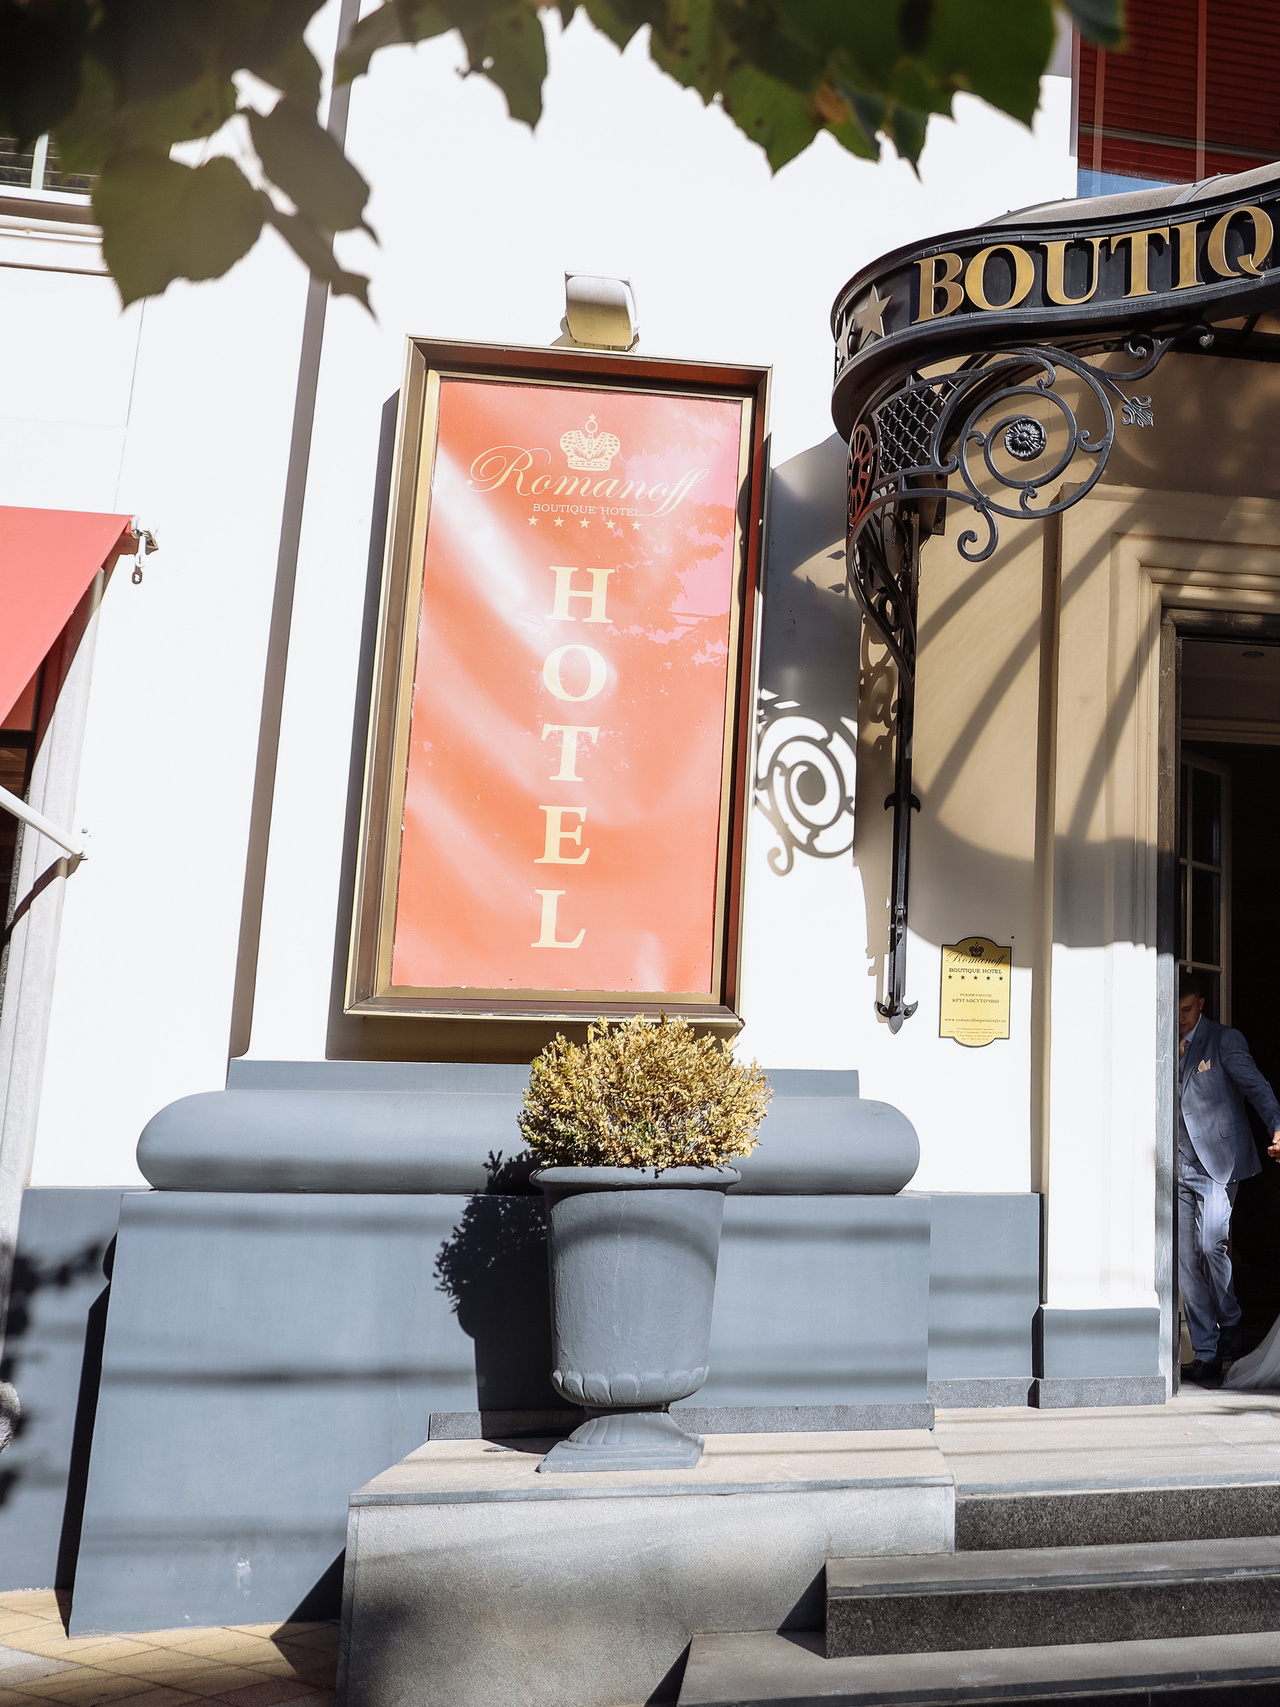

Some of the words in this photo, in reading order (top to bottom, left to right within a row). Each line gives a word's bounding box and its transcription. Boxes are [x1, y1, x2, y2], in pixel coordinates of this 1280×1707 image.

[466, 445, 709, 517] Romanoff
[533, 503, 596, 515] BOUTIQUE
[601, 506, 642, 517] HOTEL
[531, 565, 616, 950] HOTEL
[946, 951, 1005, 967] Romanoff
